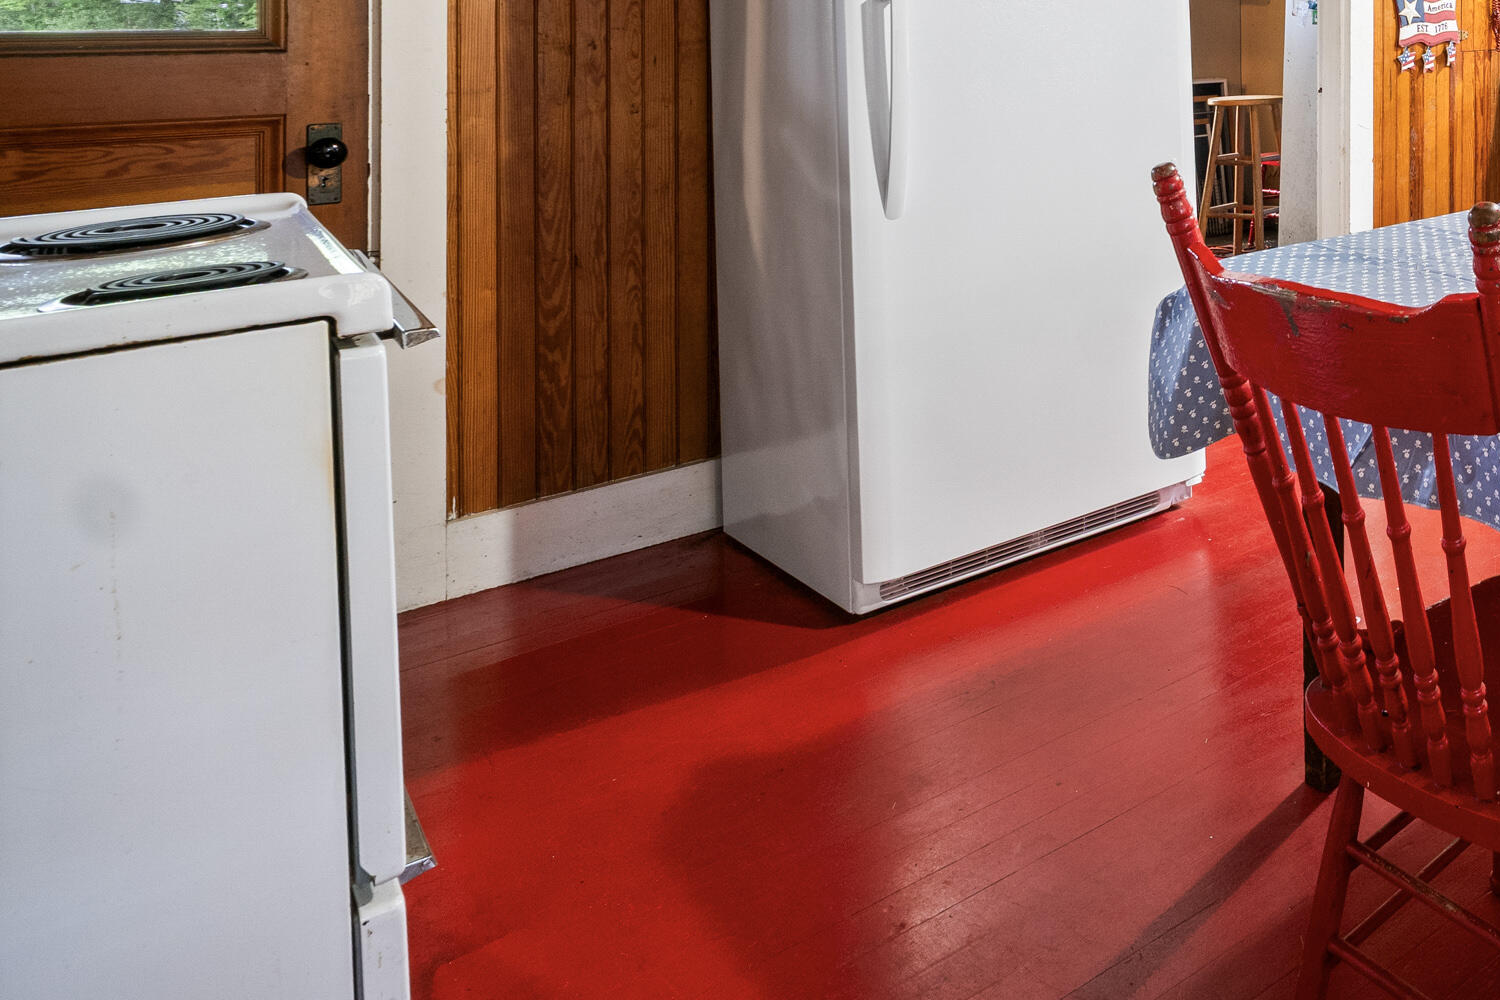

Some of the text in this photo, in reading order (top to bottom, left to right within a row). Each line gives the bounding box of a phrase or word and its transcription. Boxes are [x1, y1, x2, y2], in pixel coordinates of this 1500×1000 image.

[1427, 2, 1453, 12] America
[1416, 23, 1448, 33] EST 1776
